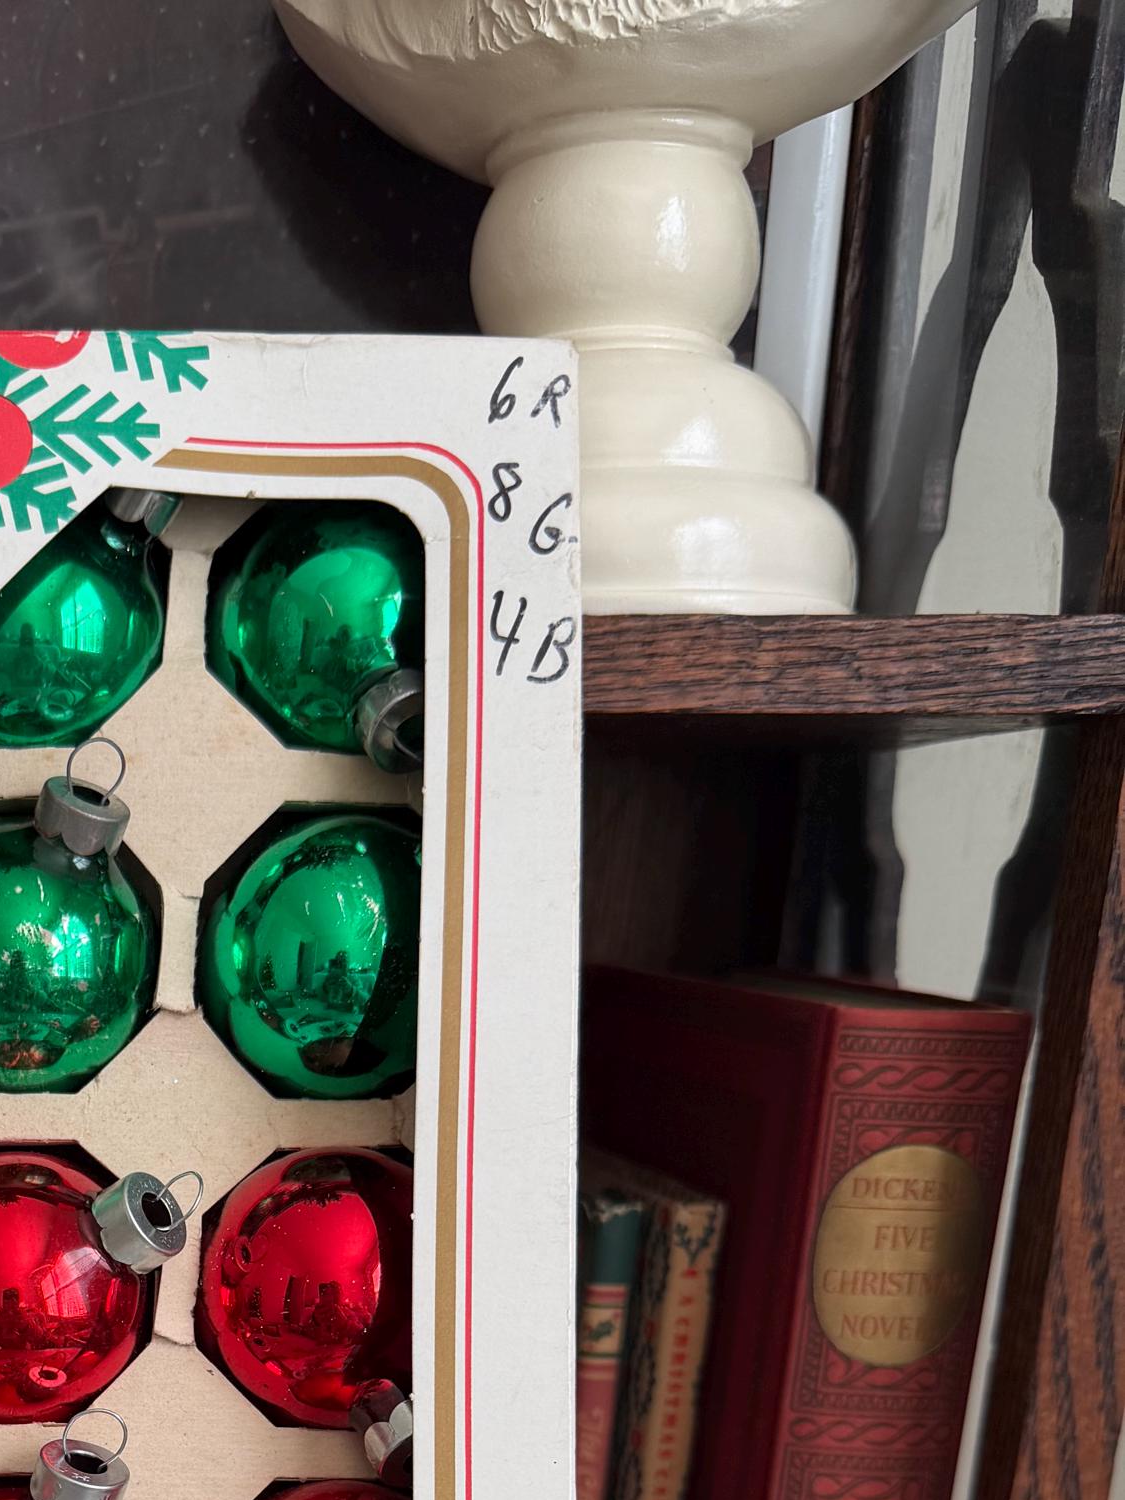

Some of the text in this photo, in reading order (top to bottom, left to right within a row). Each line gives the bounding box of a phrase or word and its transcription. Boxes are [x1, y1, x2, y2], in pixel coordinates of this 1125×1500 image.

[487, 355, 571, 428] 6 R
[487, 461, 523, 523] 8
[489, 589, 577, 684] 4 B
[873, 1225, 938, 1251] FIVE
